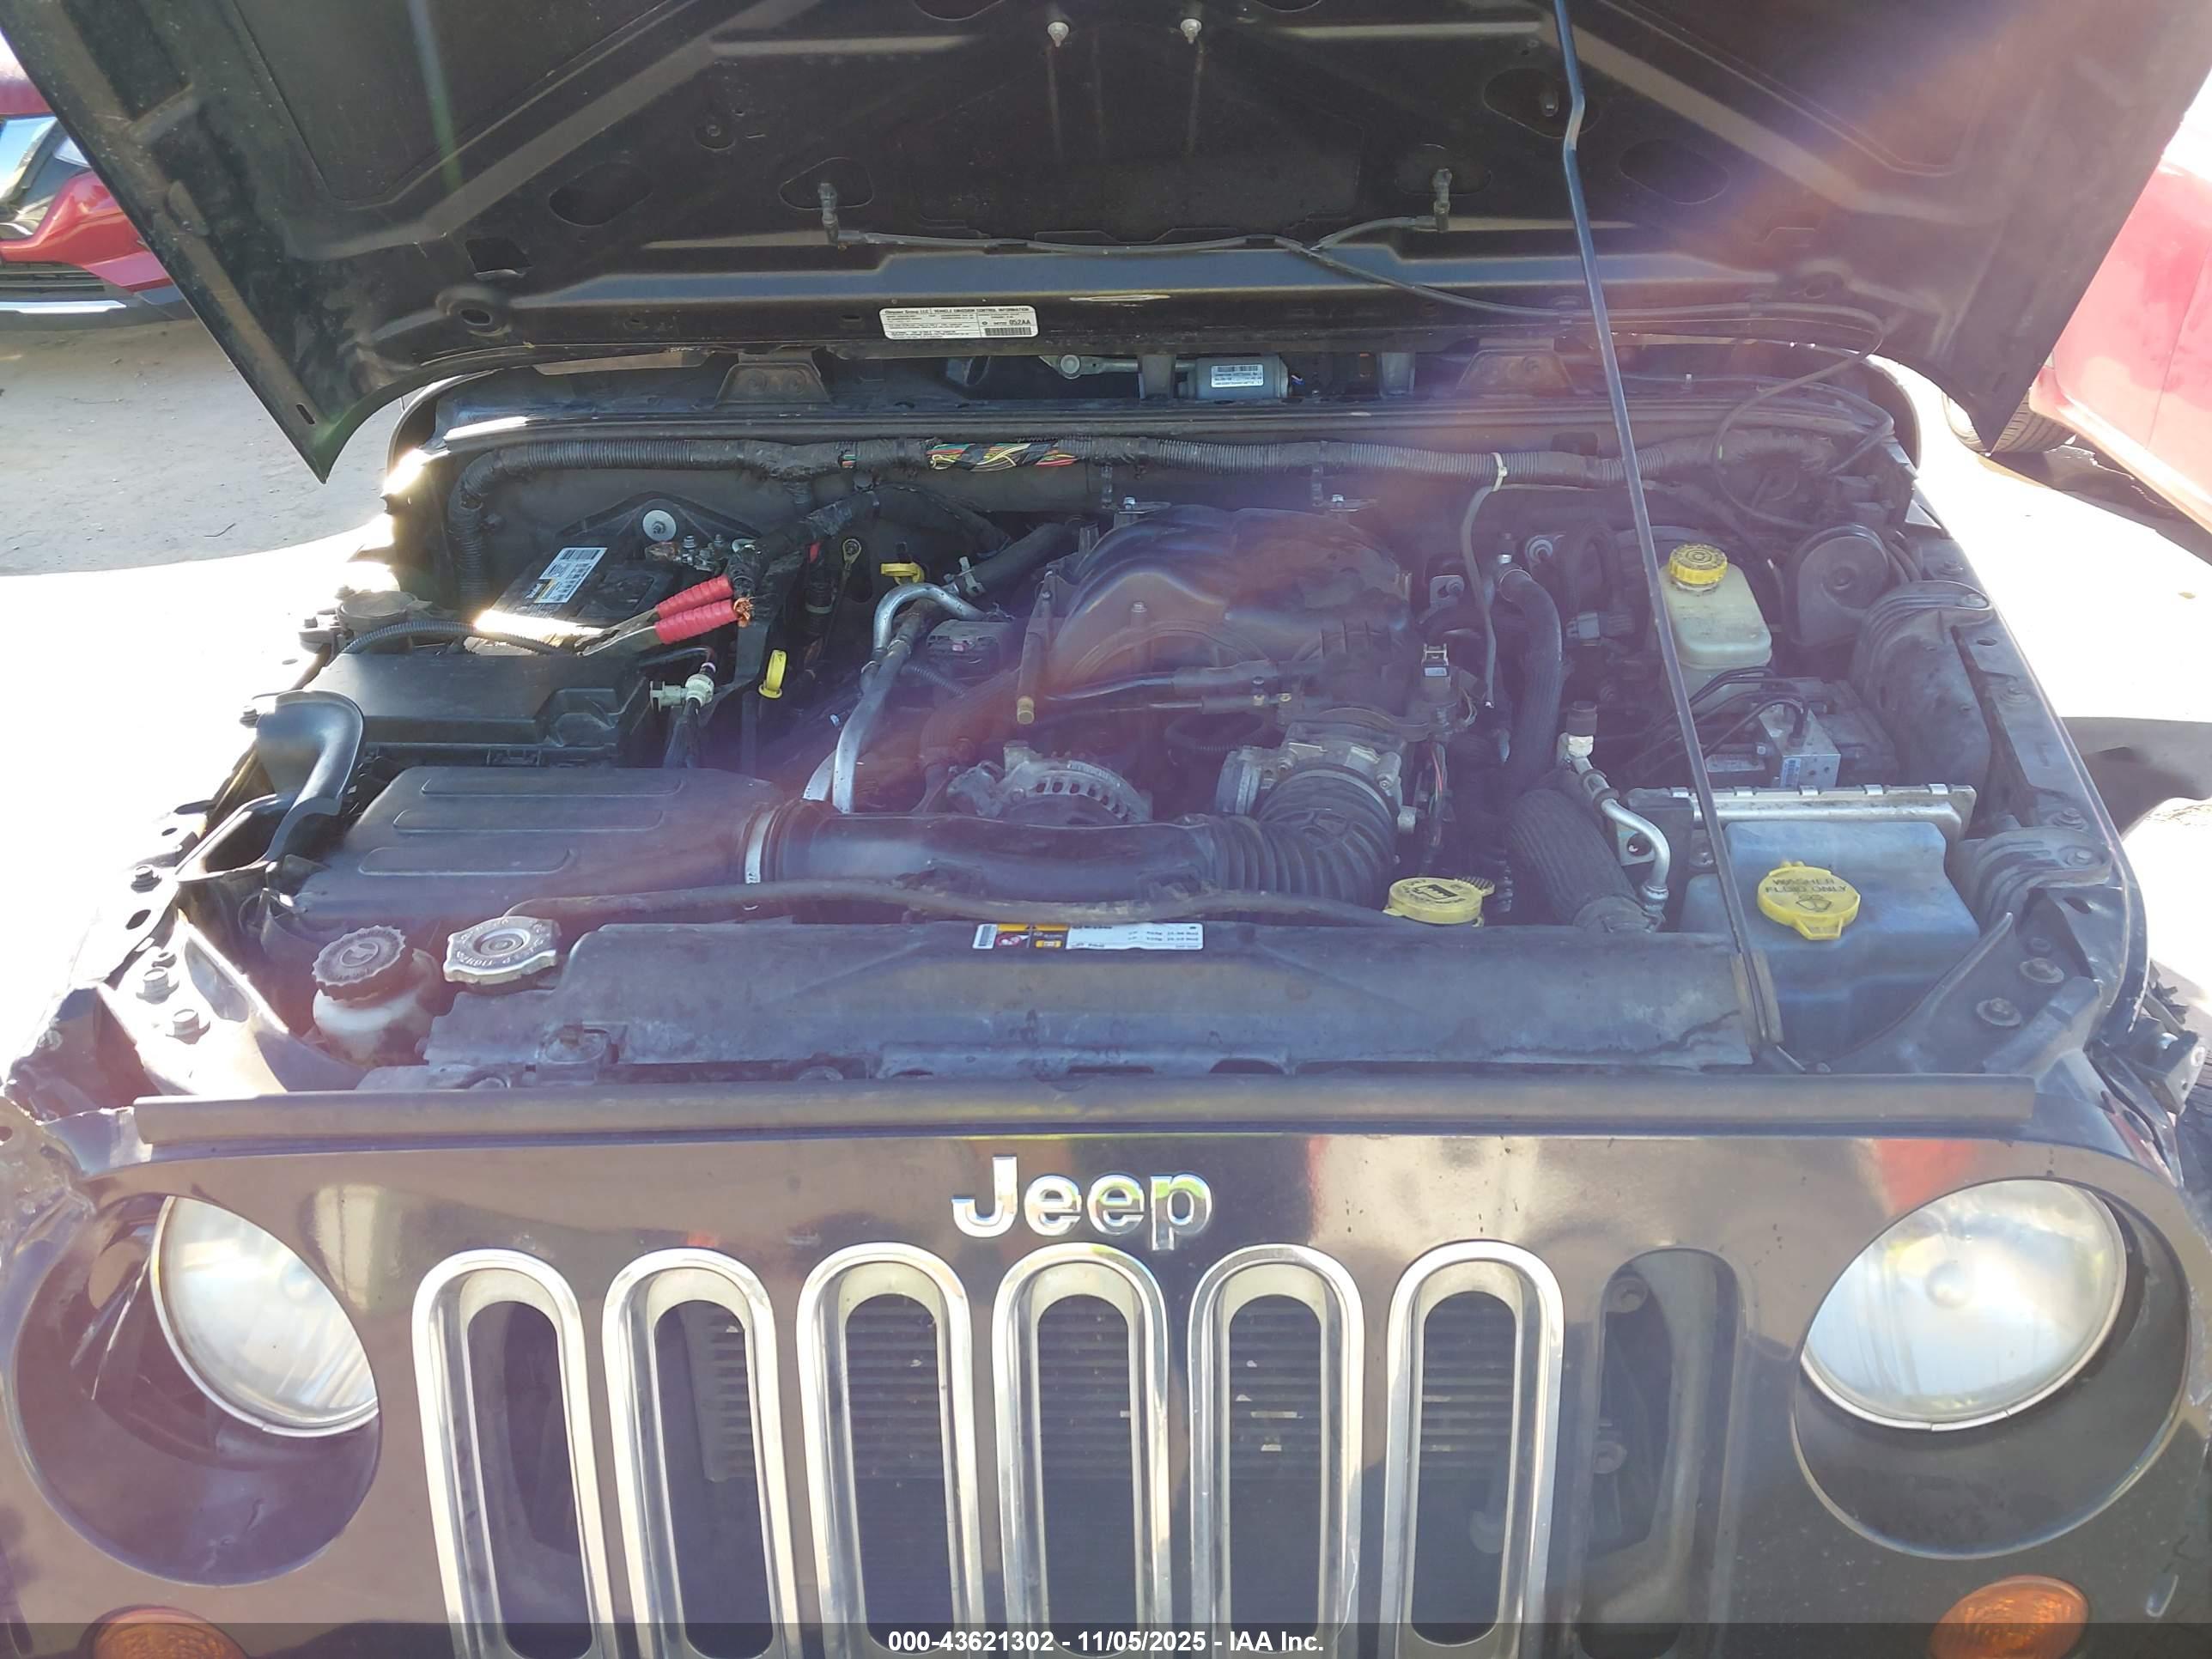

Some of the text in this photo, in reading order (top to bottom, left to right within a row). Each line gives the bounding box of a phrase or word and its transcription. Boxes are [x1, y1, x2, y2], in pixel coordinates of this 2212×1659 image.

[1772, 878, 1835, 886] WASHER
[1812, 884, 1848, 893] ONLY
[951, 1153, 1213, 1251] Jeep
